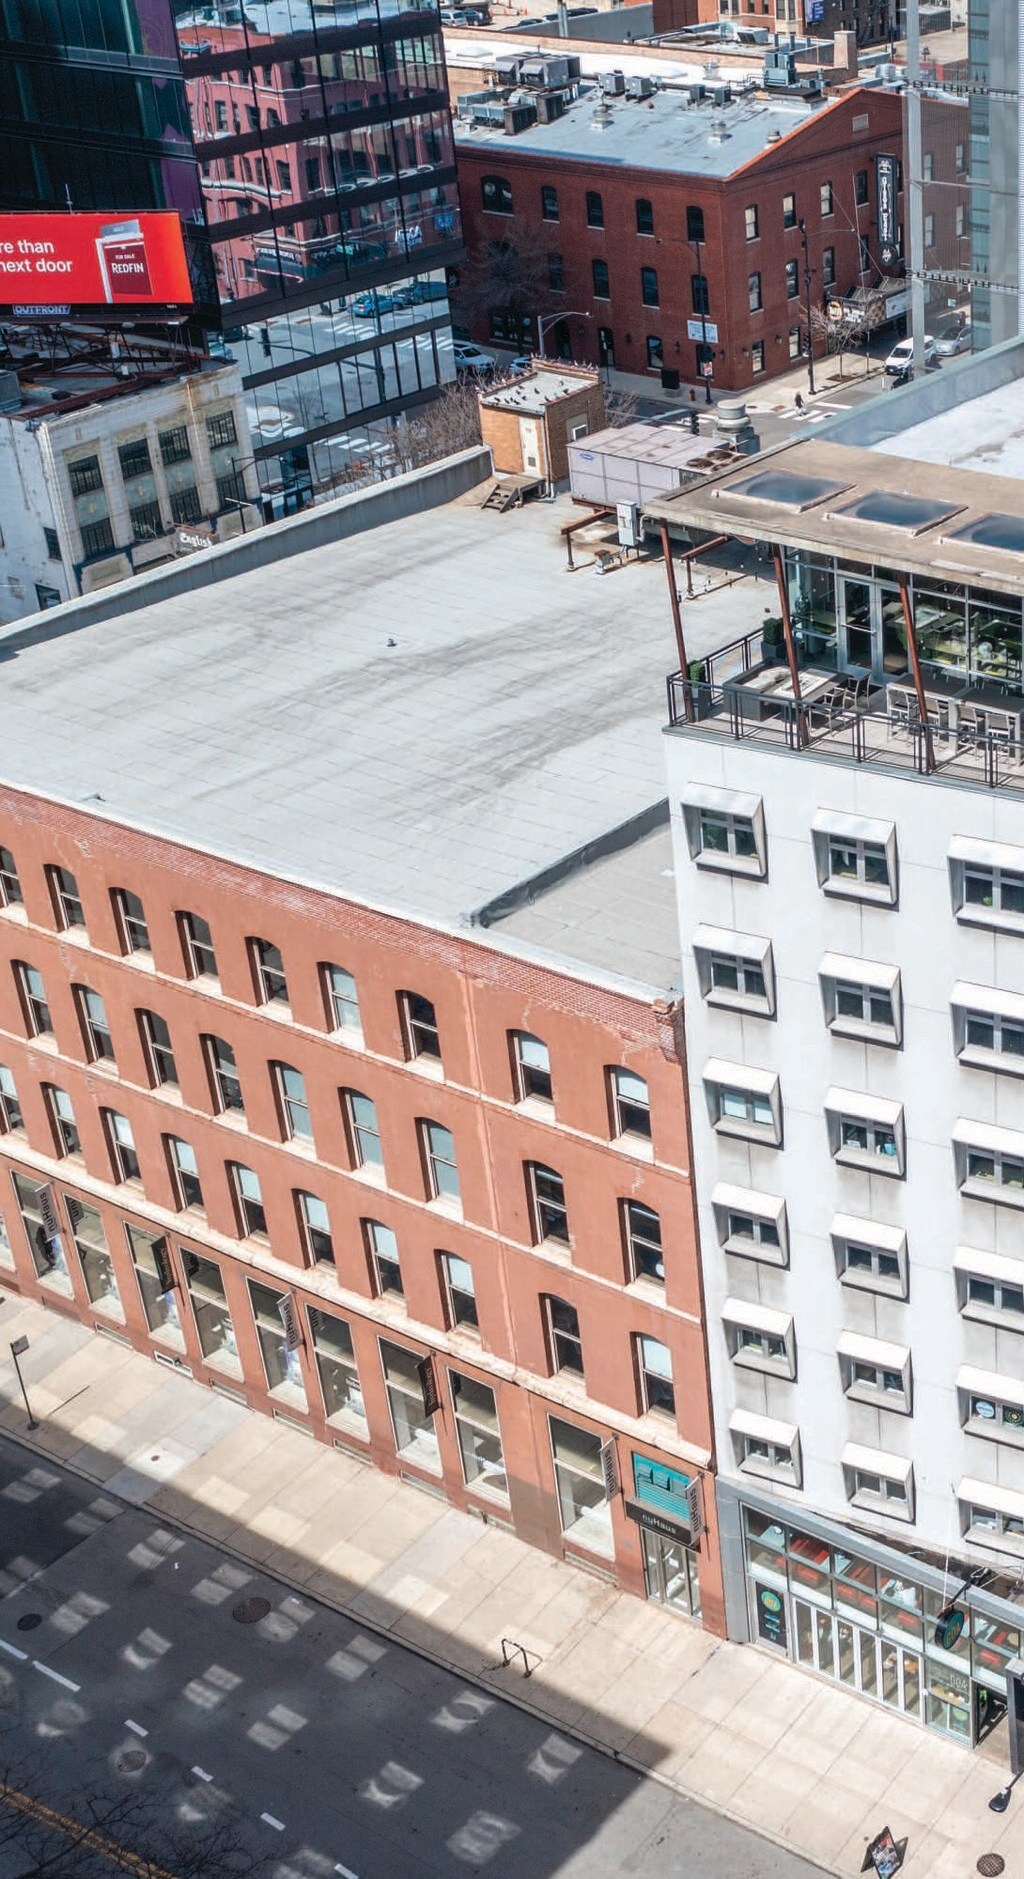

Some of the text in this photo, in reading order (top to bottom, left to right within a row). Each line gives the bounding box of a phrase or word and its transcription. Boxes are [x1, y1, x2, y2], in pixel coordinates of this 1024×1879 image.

[17, 240, 55, 253] than
[36, 258, 73, 272] door
[111, 262, 145, 274] REDFIN
[13, 305, 70, 315] OUTFRONT
